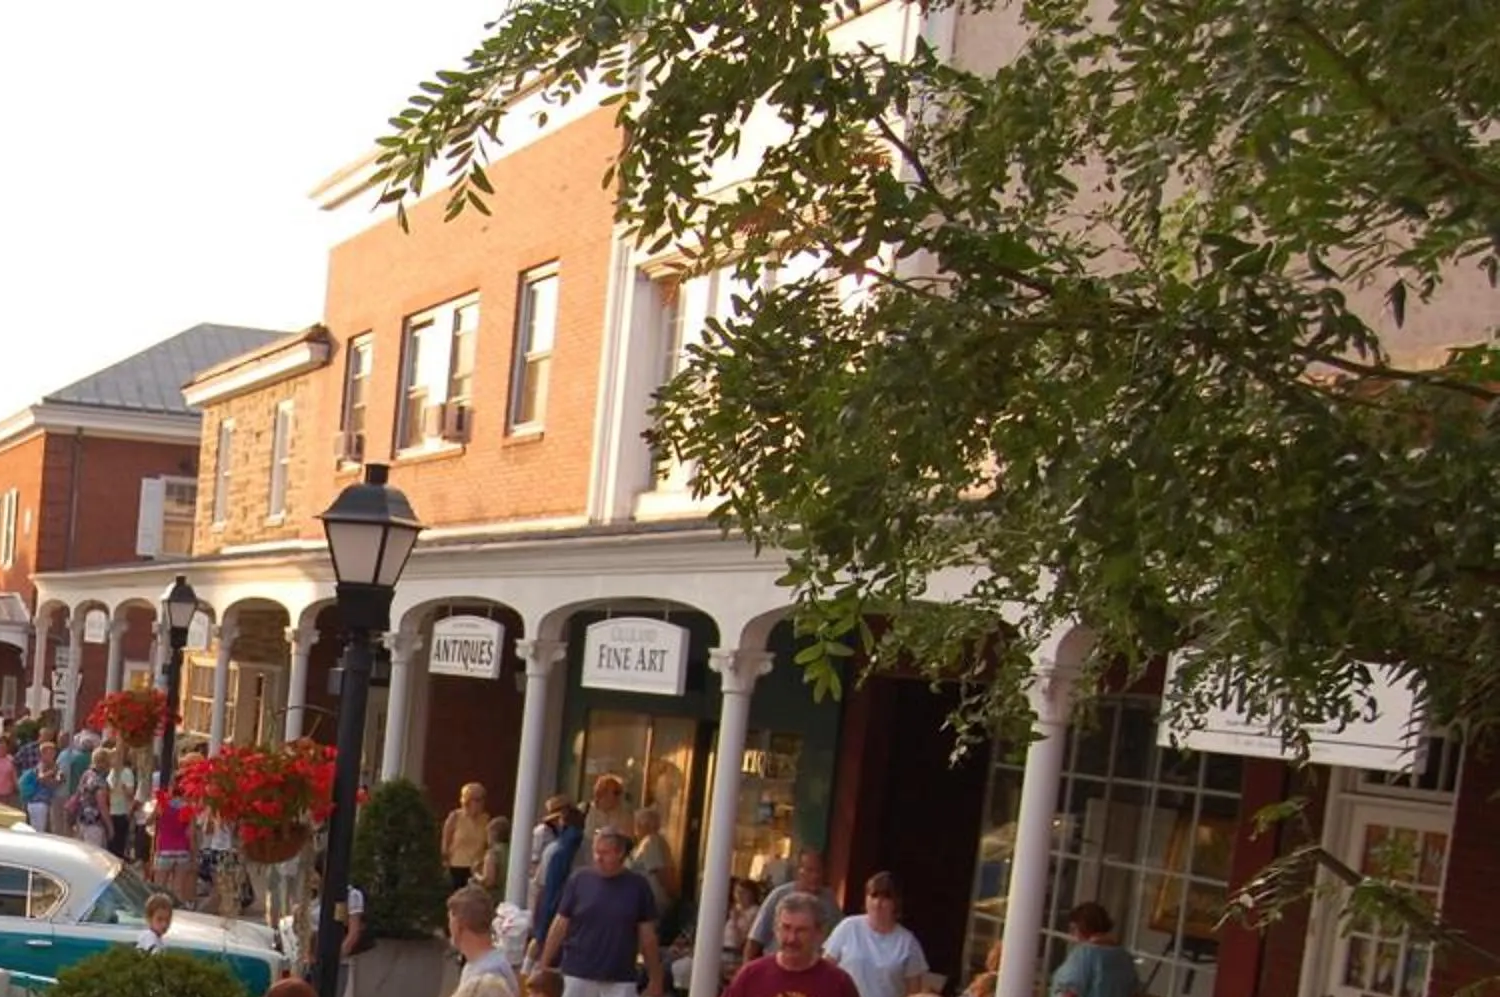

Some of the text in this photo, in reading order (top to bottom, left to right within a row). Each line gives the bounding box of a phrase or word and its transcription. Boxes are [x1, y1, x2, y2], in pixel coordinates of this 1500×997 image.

[434, 639, 494, 671] ANTIQUES
[597, 643, 669, 673] FINE ART
